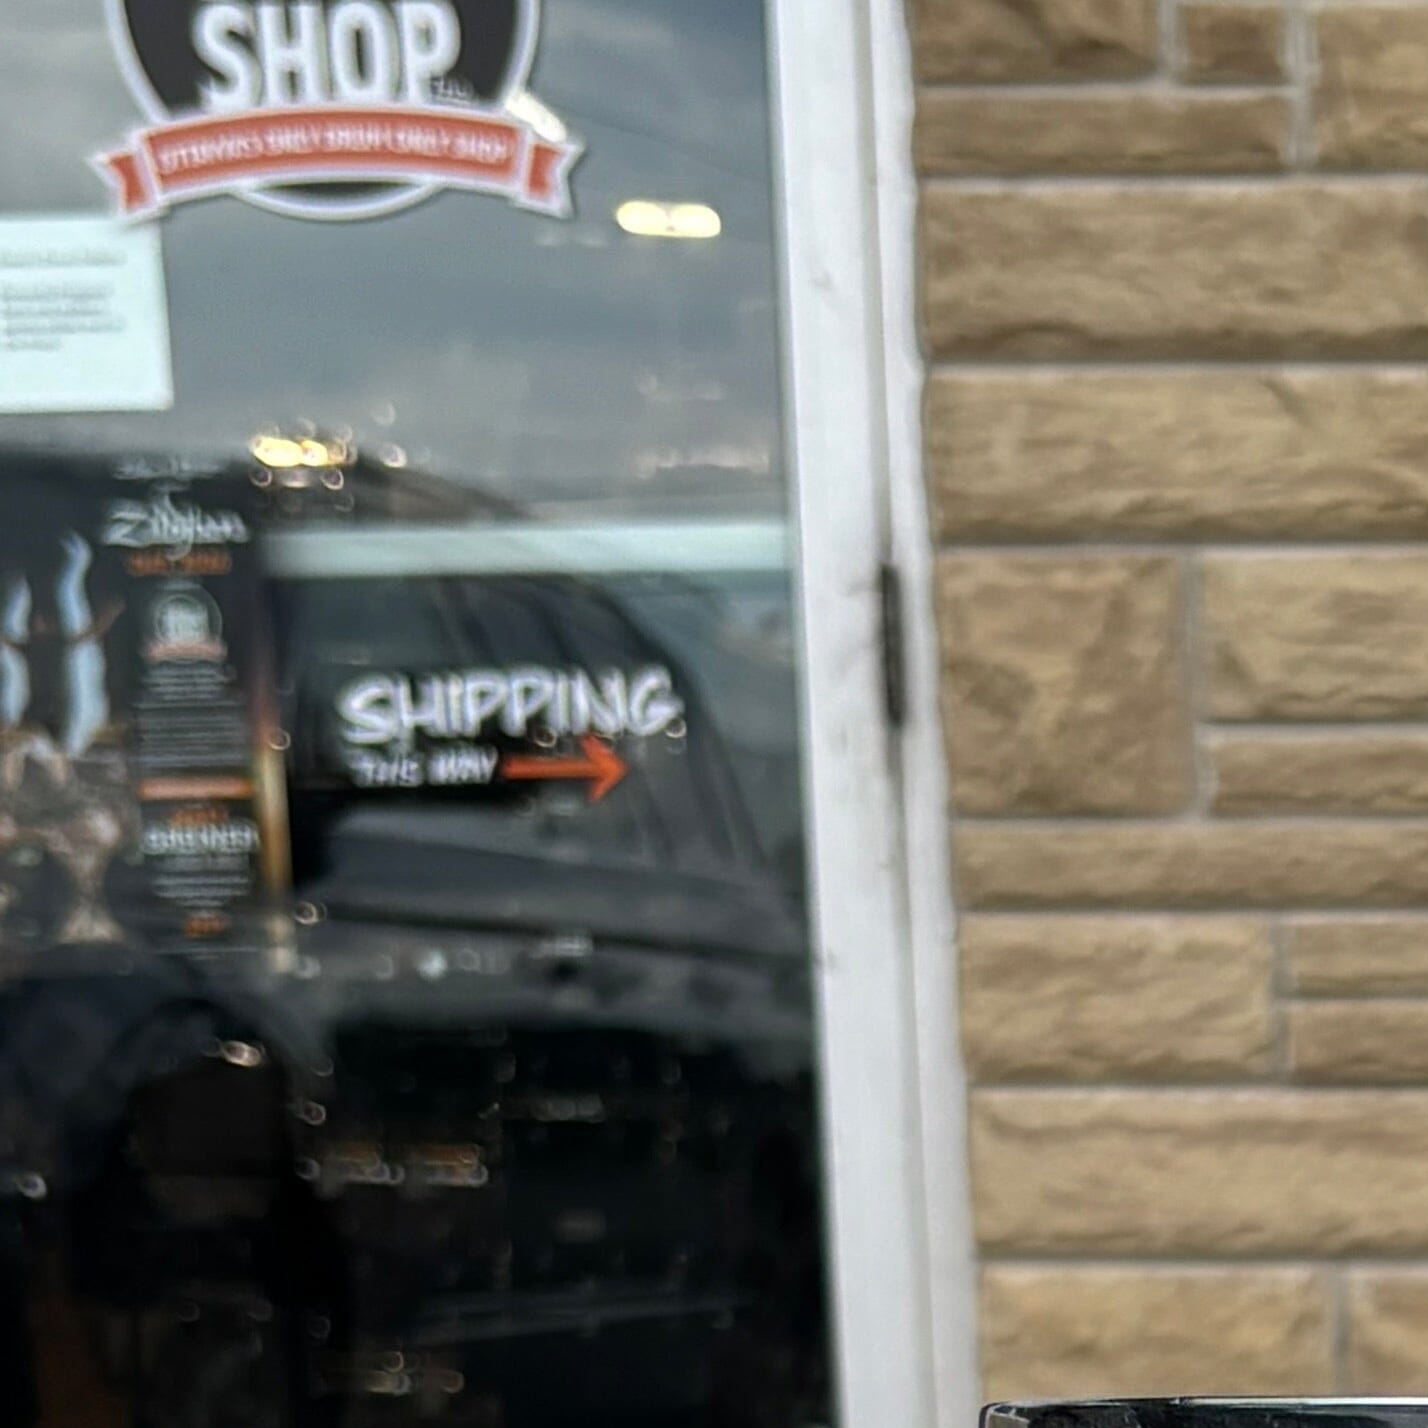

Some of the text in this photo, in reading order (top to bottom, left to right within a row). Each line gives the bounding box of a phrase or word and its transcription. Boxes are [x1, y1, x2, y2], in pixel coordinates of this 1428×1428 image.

[193, 0, 462, 102] SHOP
[338, 663, 686, 748] SHIPPING
[428, 745, 499, 786] WAY
